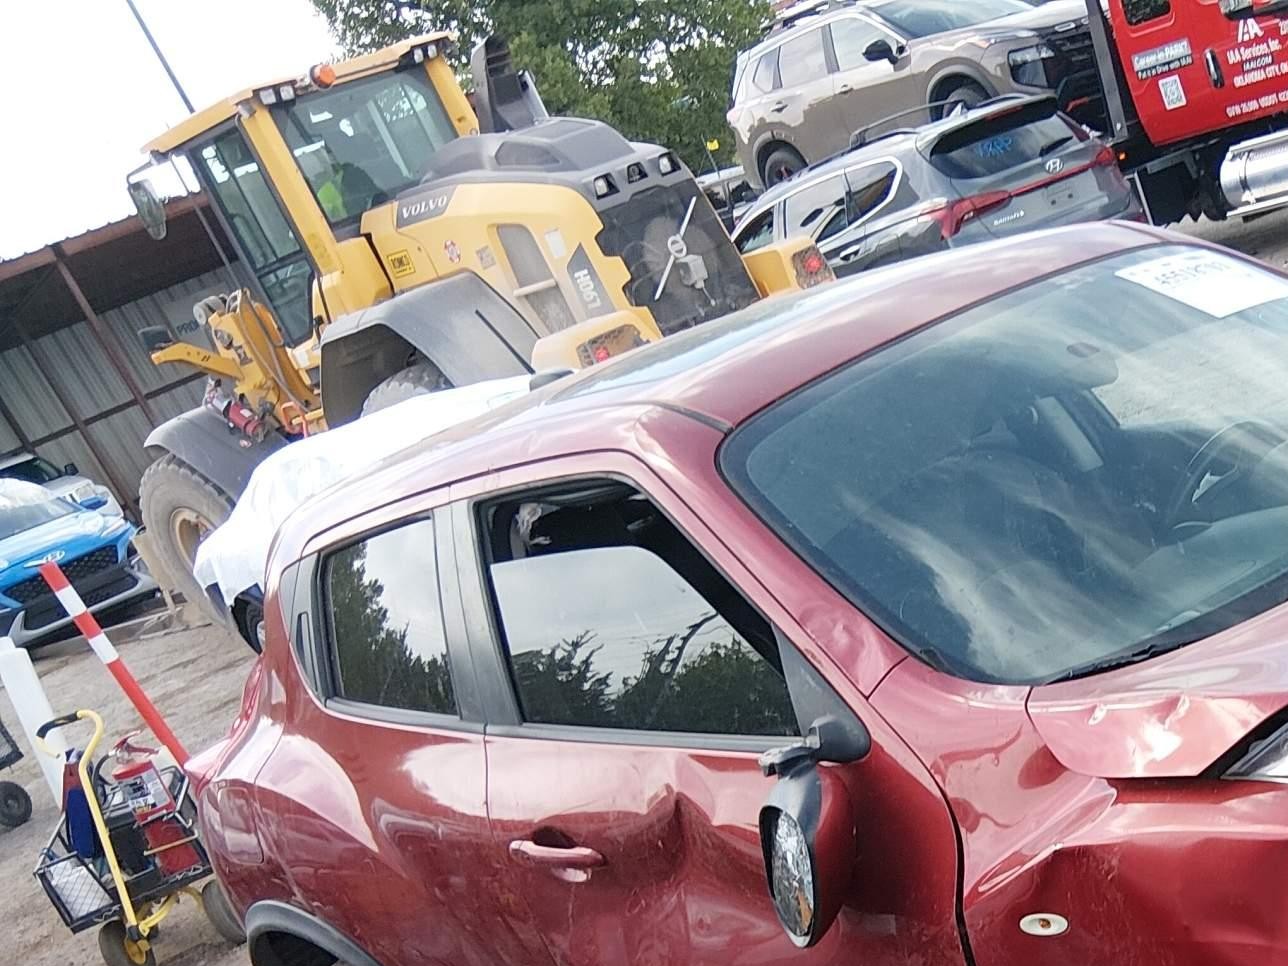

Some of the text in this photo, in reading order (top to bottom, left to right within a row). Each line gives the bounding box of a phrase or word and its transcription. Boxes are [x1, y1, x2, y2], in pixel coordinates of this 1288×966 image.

[1227, 47, 1241, 64] IAA
[1233, 68, 1266, 88] OKLAHOMA
[402, 195, 447, 218] VOLVO
